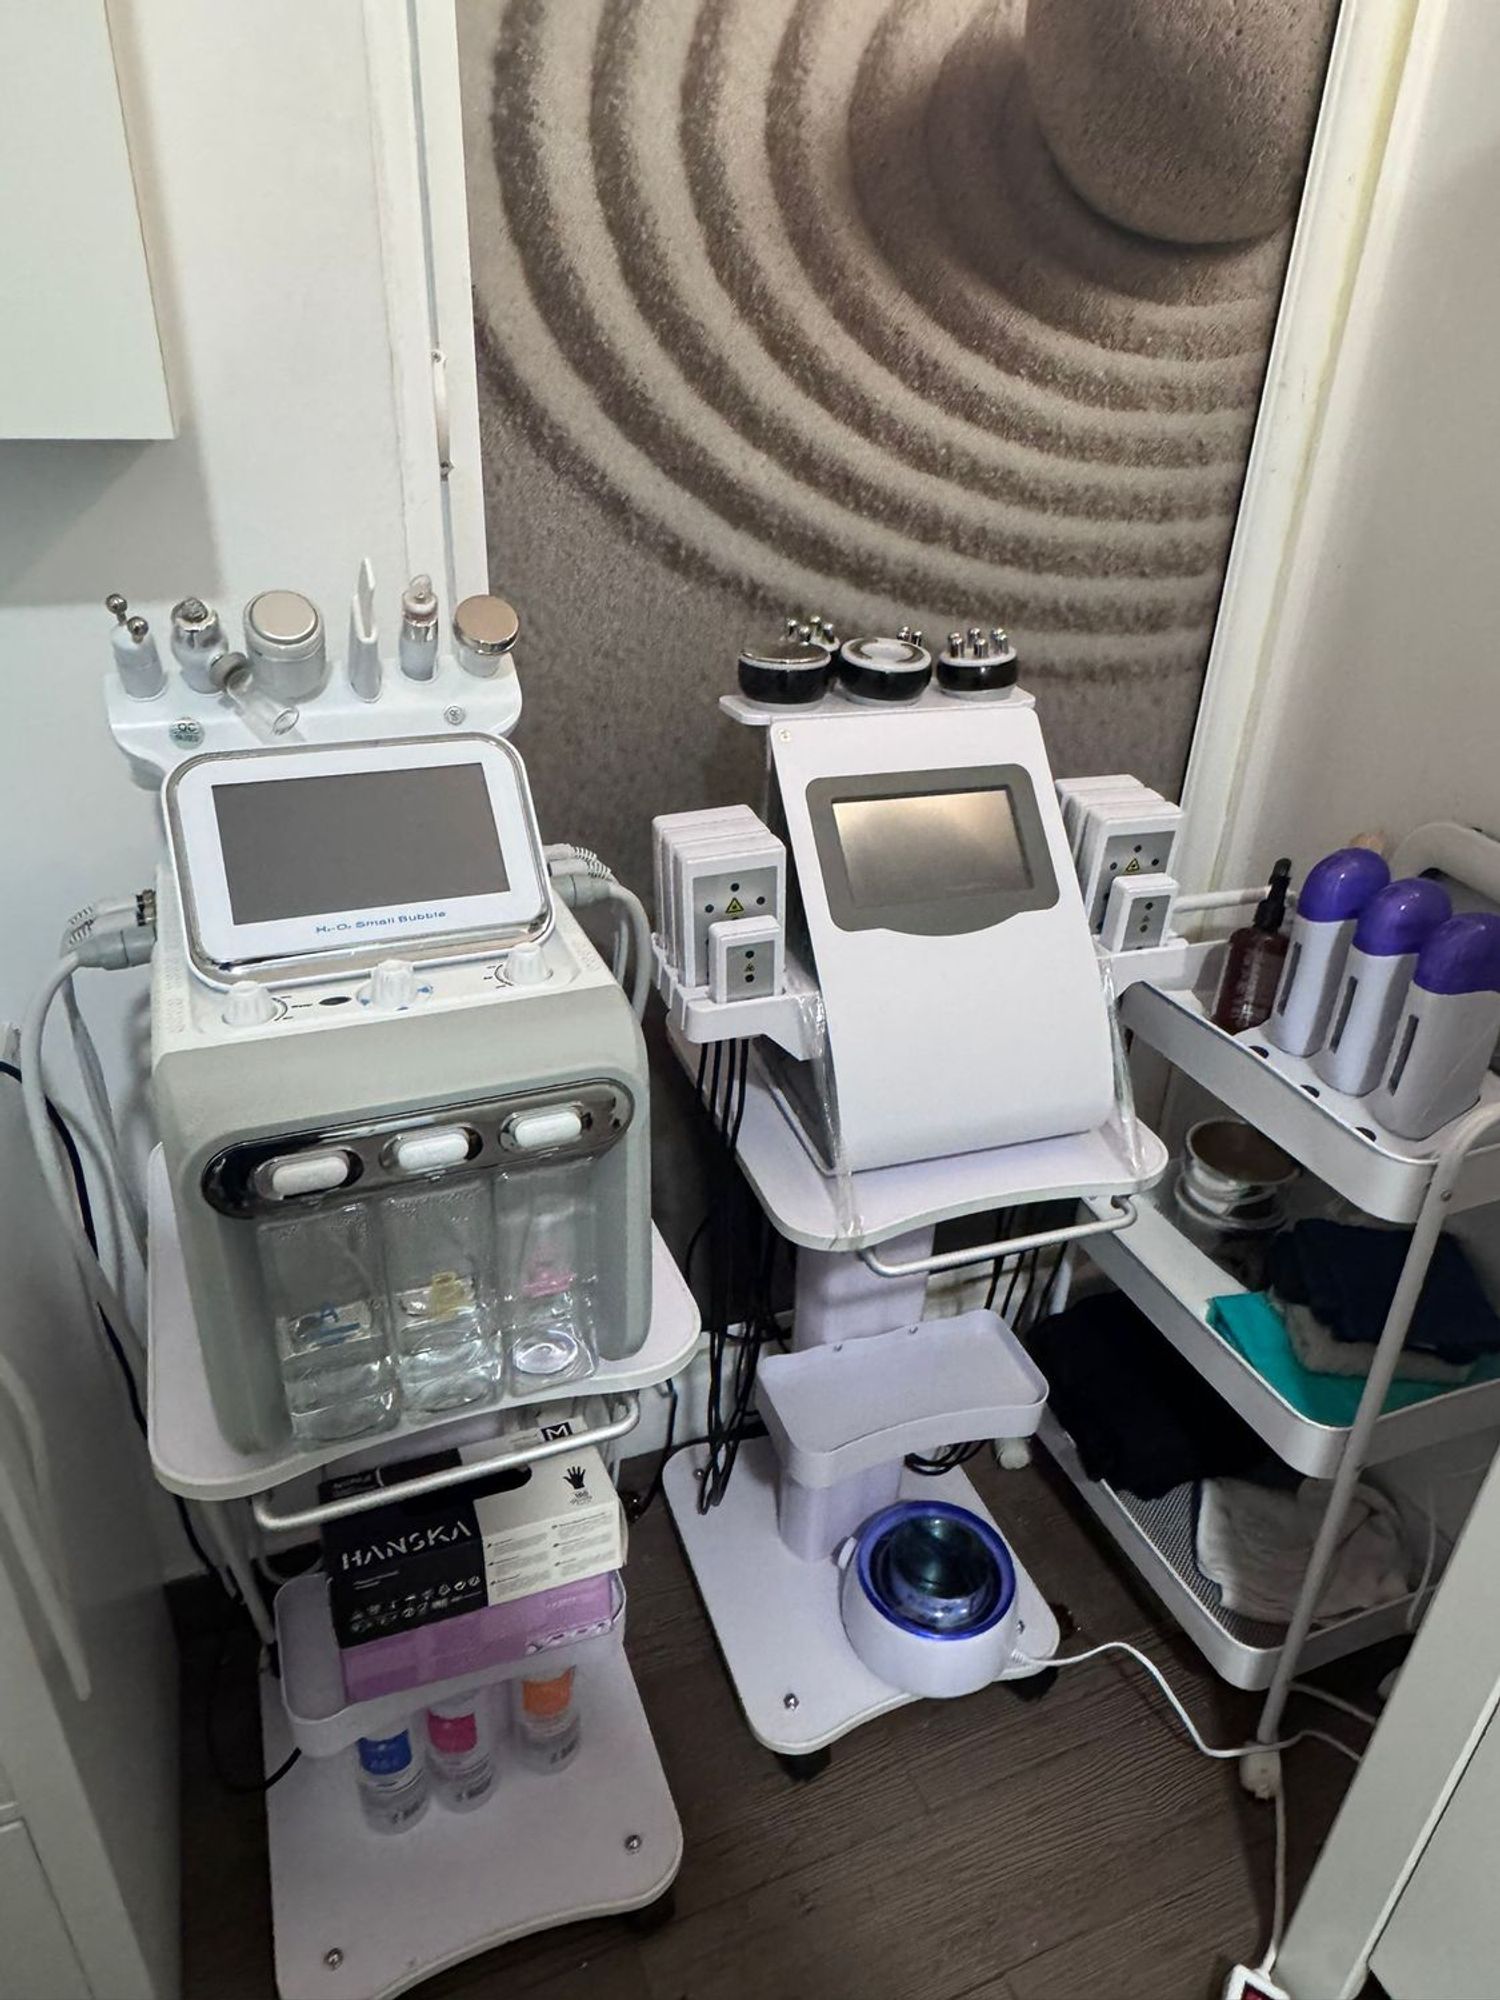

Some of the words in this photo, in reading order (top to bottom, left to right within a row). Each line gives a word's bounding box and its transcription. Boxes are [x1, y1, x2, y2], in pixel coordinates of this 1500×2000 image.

[355, 917, 395, 929] Small
[398, 911, 447, 923] Bubble
[545, 1424, 569, 1440] M
[342, 1520, 472, 1570] HANSKA
